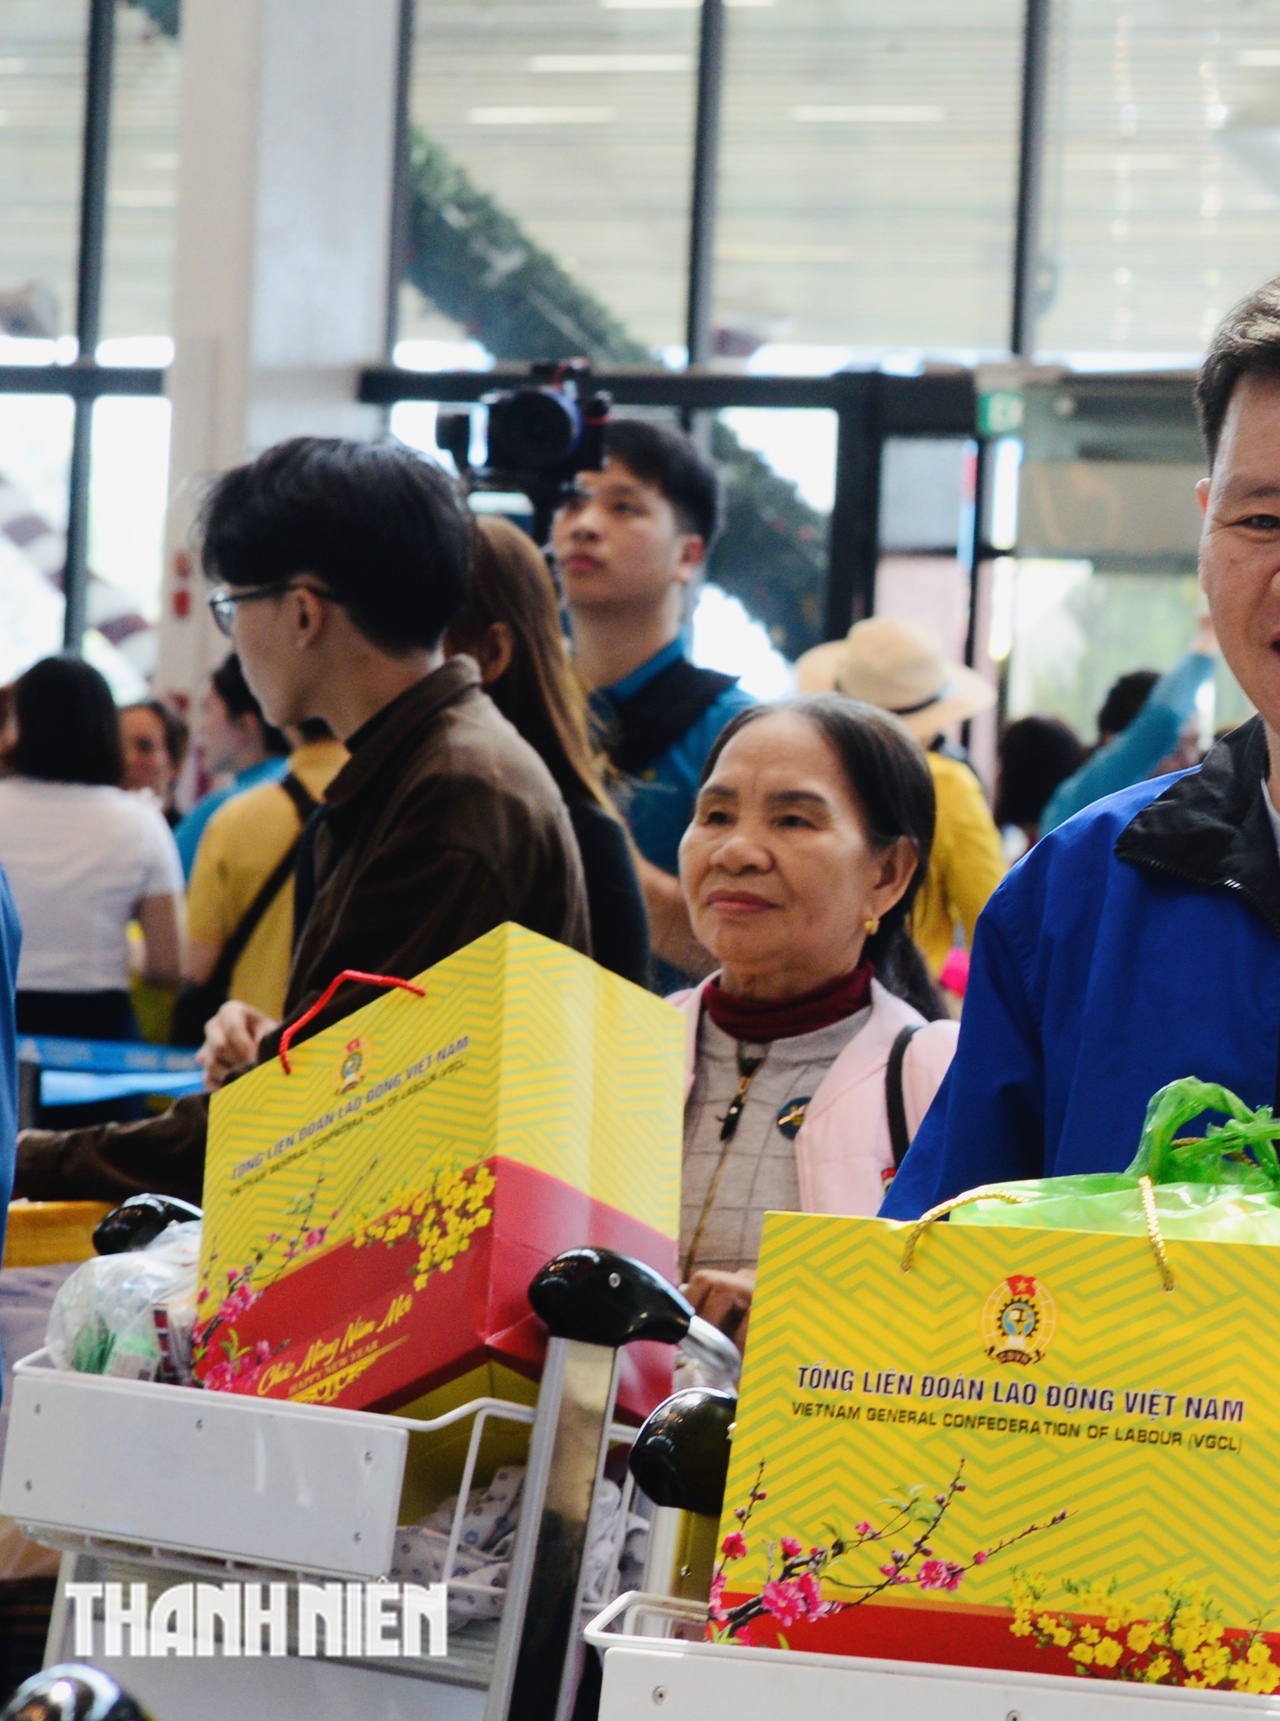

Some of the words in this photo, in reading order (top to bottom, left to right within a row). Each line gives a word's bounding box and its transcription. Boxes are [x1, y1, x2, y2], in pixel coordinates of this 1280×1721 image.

[437, 1036, 469, 1063] NAM
[798, 1358, 855, 1391] TỔNG
[863, 1367, 914, 1396] LIÊN
[920, 1373, 985, 1402] ĐOÀN
[993, 1381, 1037, 1406] LAO
[1046, 1381, 1115, 1414] ĐỘNG
[1124, 1388, 1177, 1421] VIỆT
[1185, 1397, 1245, 1422] NAM
[792, 1402, 861, 1421] VIETNAM
[867, 1407, 936, 1426] GENERAL
[942, 1413, 1080, 1438] CONFEDERATION
[1087, 1425, 1109, 1440] OF
[1114, 1427, 1182, 1446] LABOUR
[1188, 1433, 1242, 1454] (VGCL)
